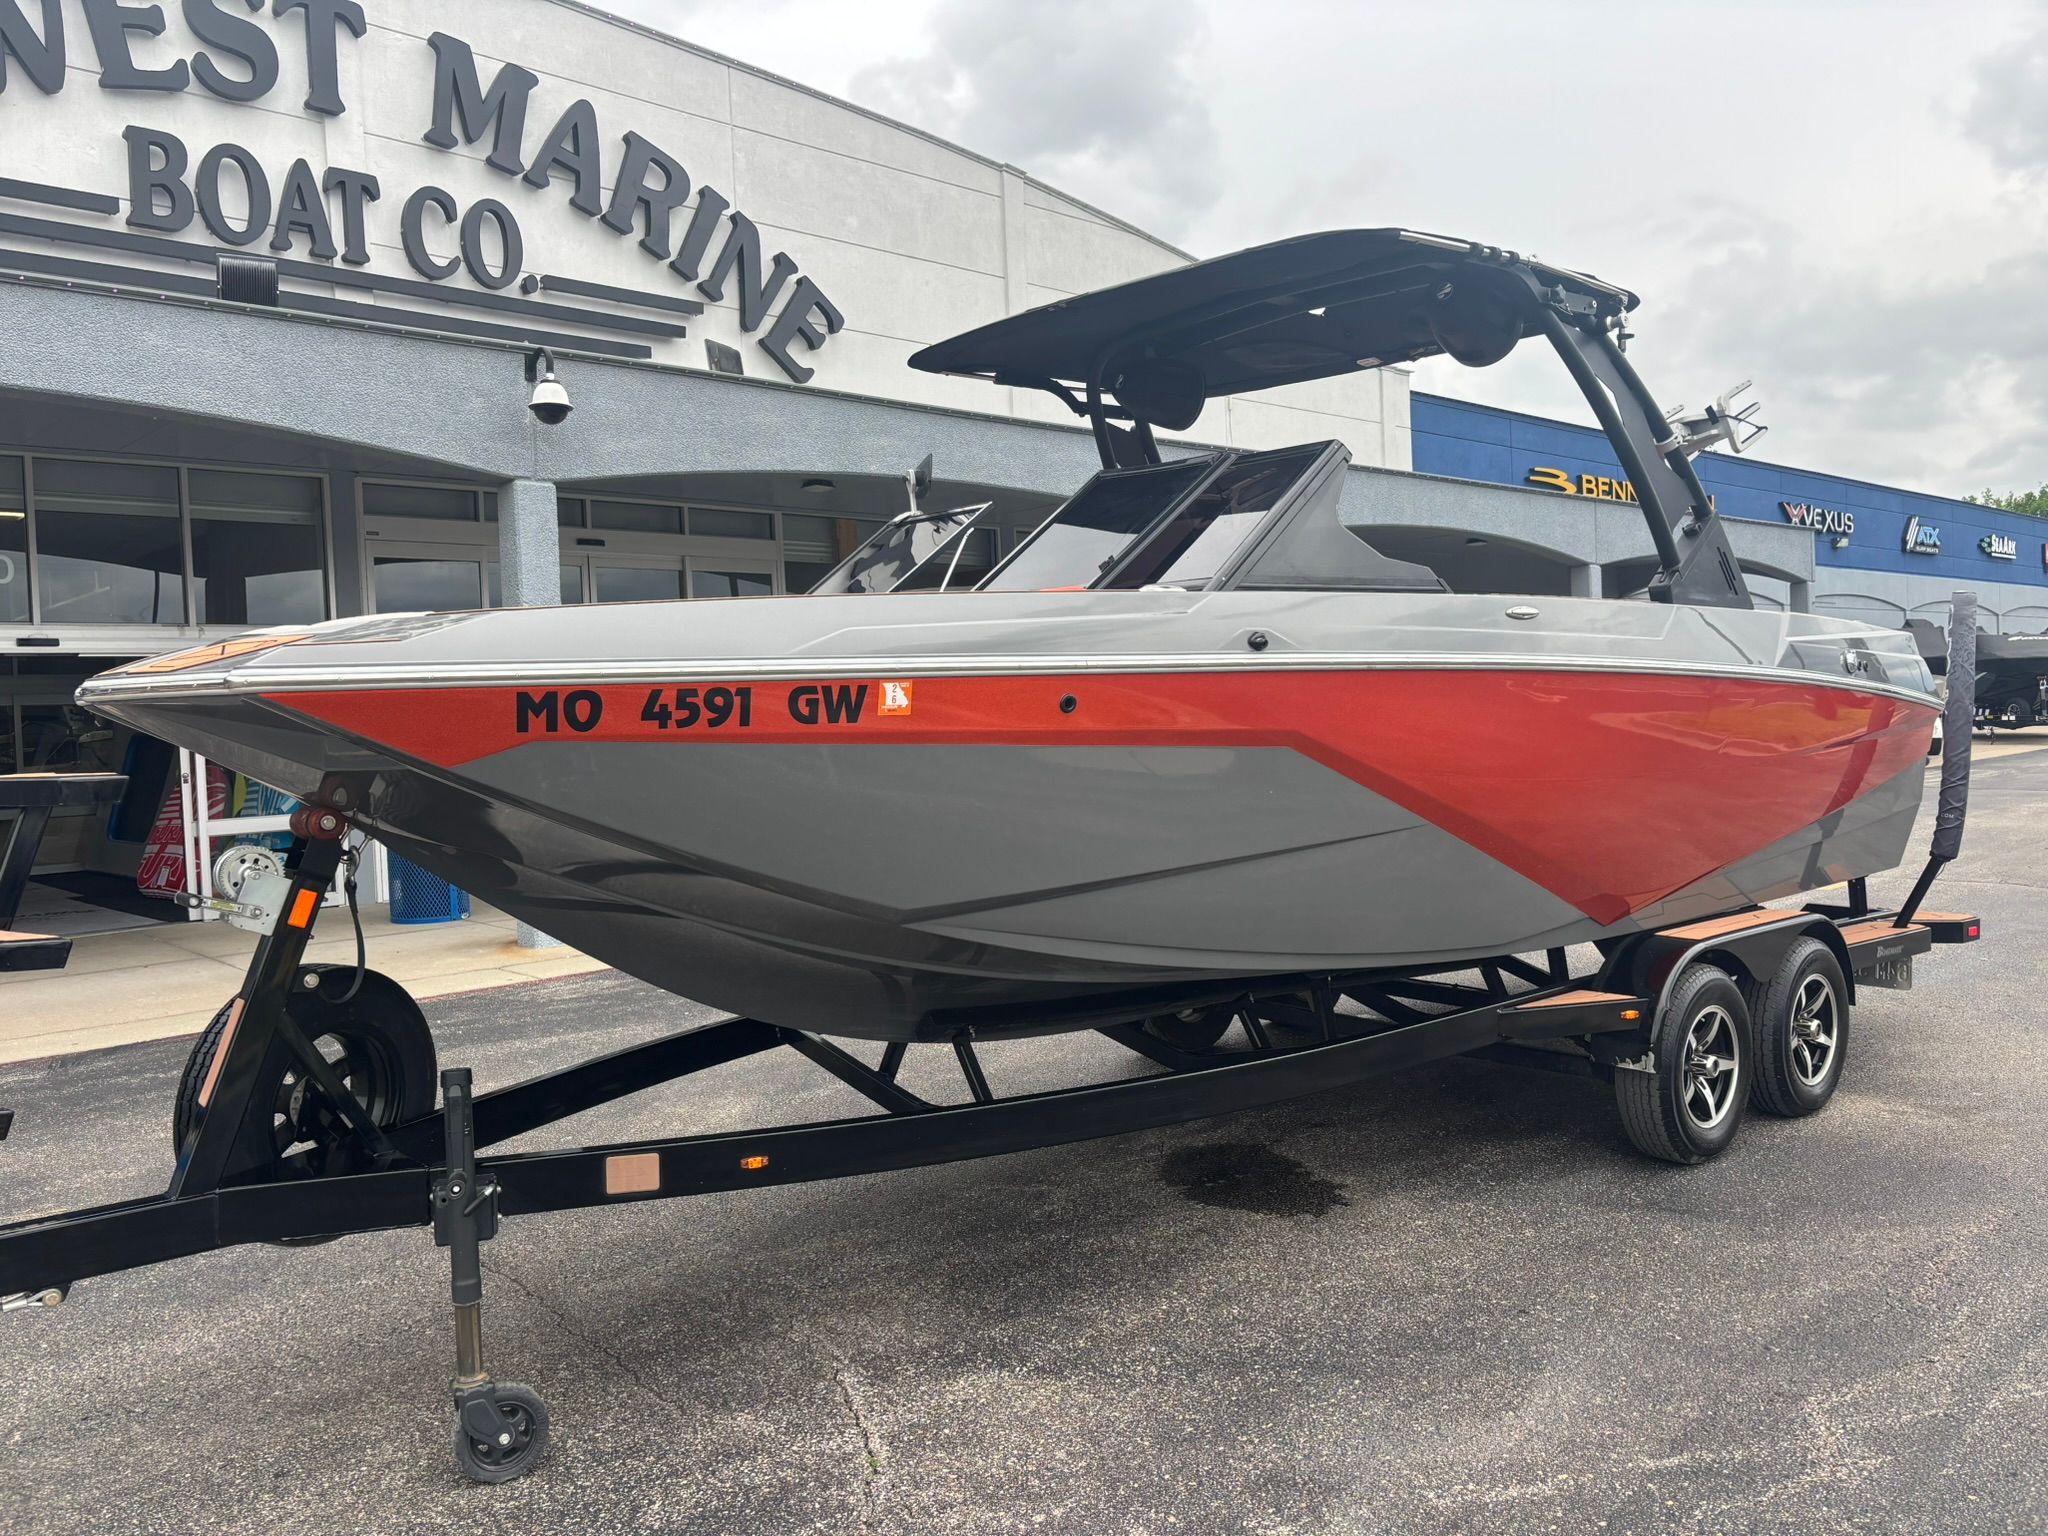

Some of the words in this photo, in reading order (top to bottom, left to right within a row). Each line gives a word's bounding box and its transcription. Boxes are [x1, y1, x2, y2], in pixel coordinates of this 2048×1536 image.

[122, 125, 381, 265] BOAT
[401, 185, 539, 294] CO.
[423, 31, 845, 384] MARINE
[1801, 502, 1854, 533] VEXUS
[1917, 526, 1941, 545] ATX
[516, 690, 603, 733] MO
[640, 687, 752, 729] 4591
[788, 685, 868, 725] GW
